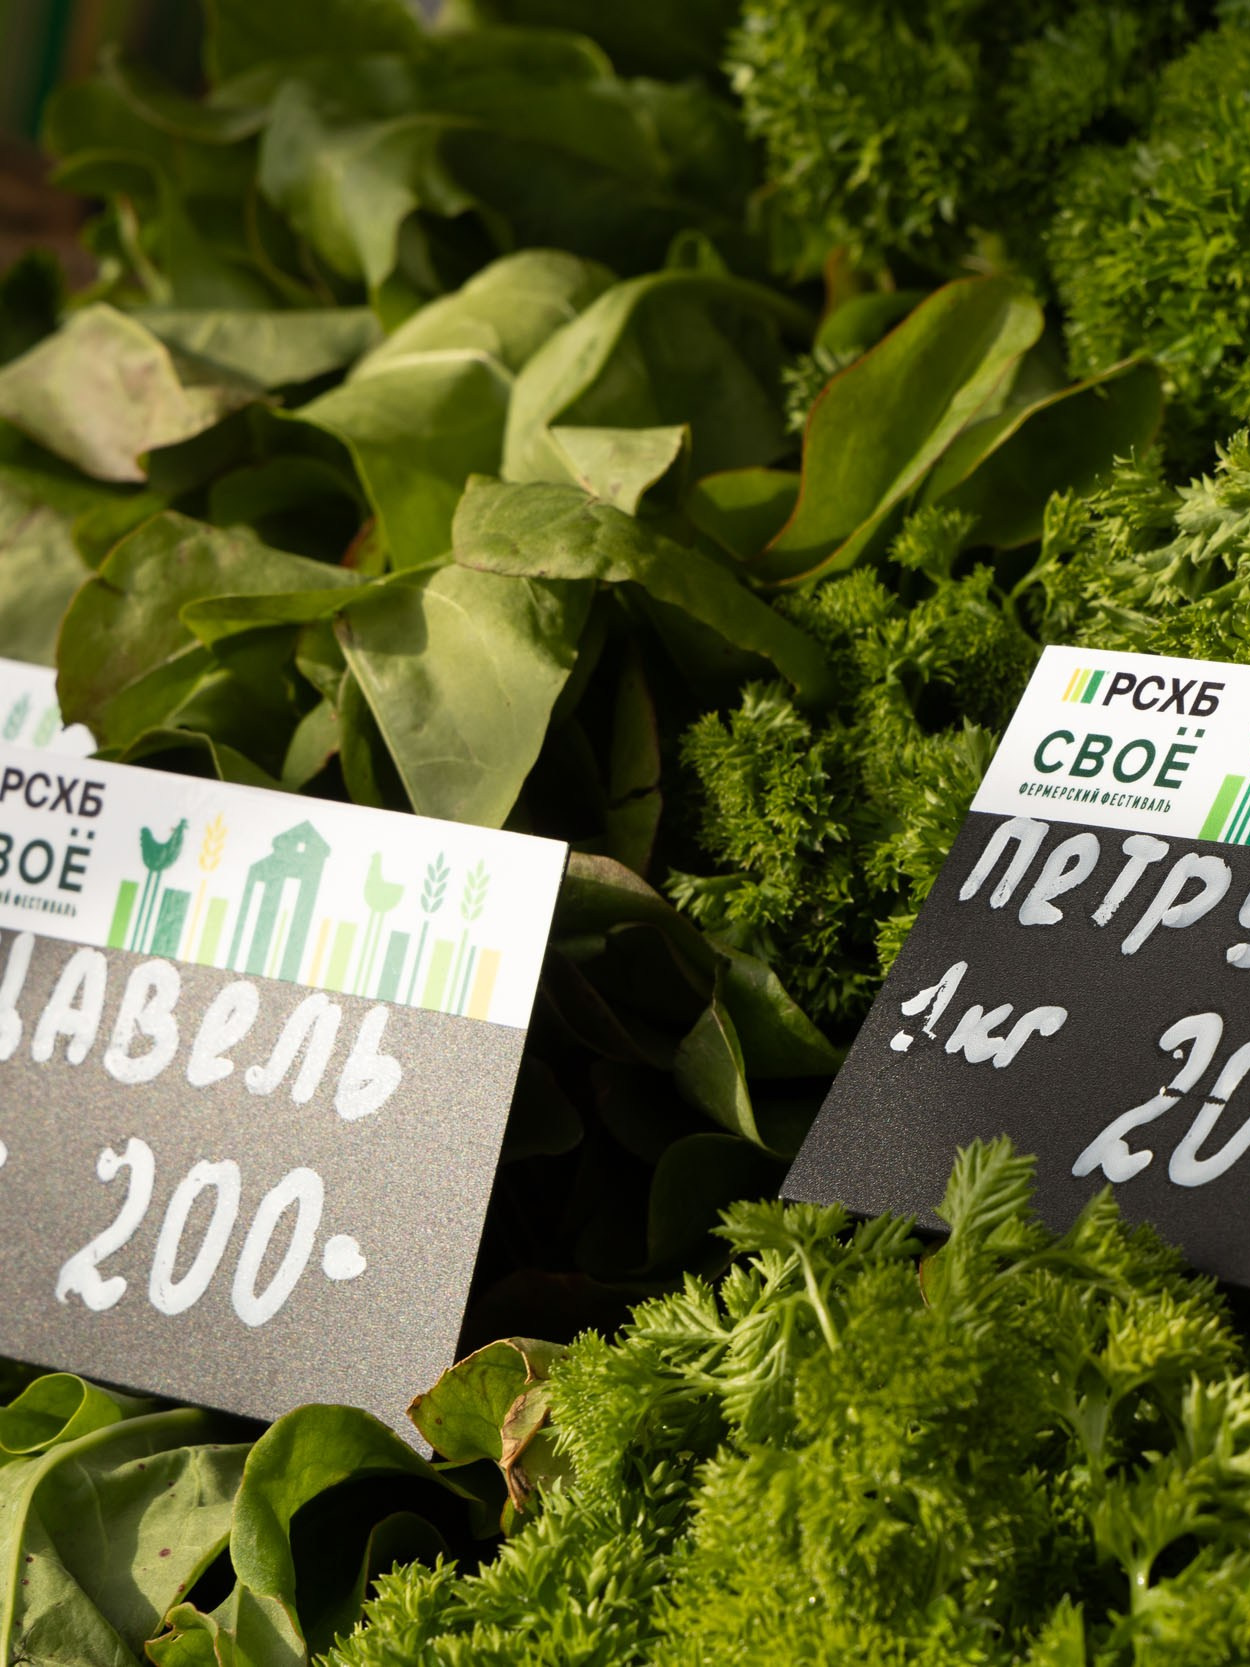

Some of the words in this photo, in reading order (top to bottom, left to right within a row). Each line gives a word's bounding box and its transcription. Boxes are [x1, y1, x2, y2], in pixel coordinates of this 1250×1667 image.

[1102, 672, 1226, 717] РСХБ
[1034, 726, 1206, 789] СВОЁ
[0, 767, 106, 818] РСХБ
[1018, 782, 1101, 804] ФЕРМЕРСКИЙ
[1101, 791, 1172, 813] ФЕСТИВАЛЬ
